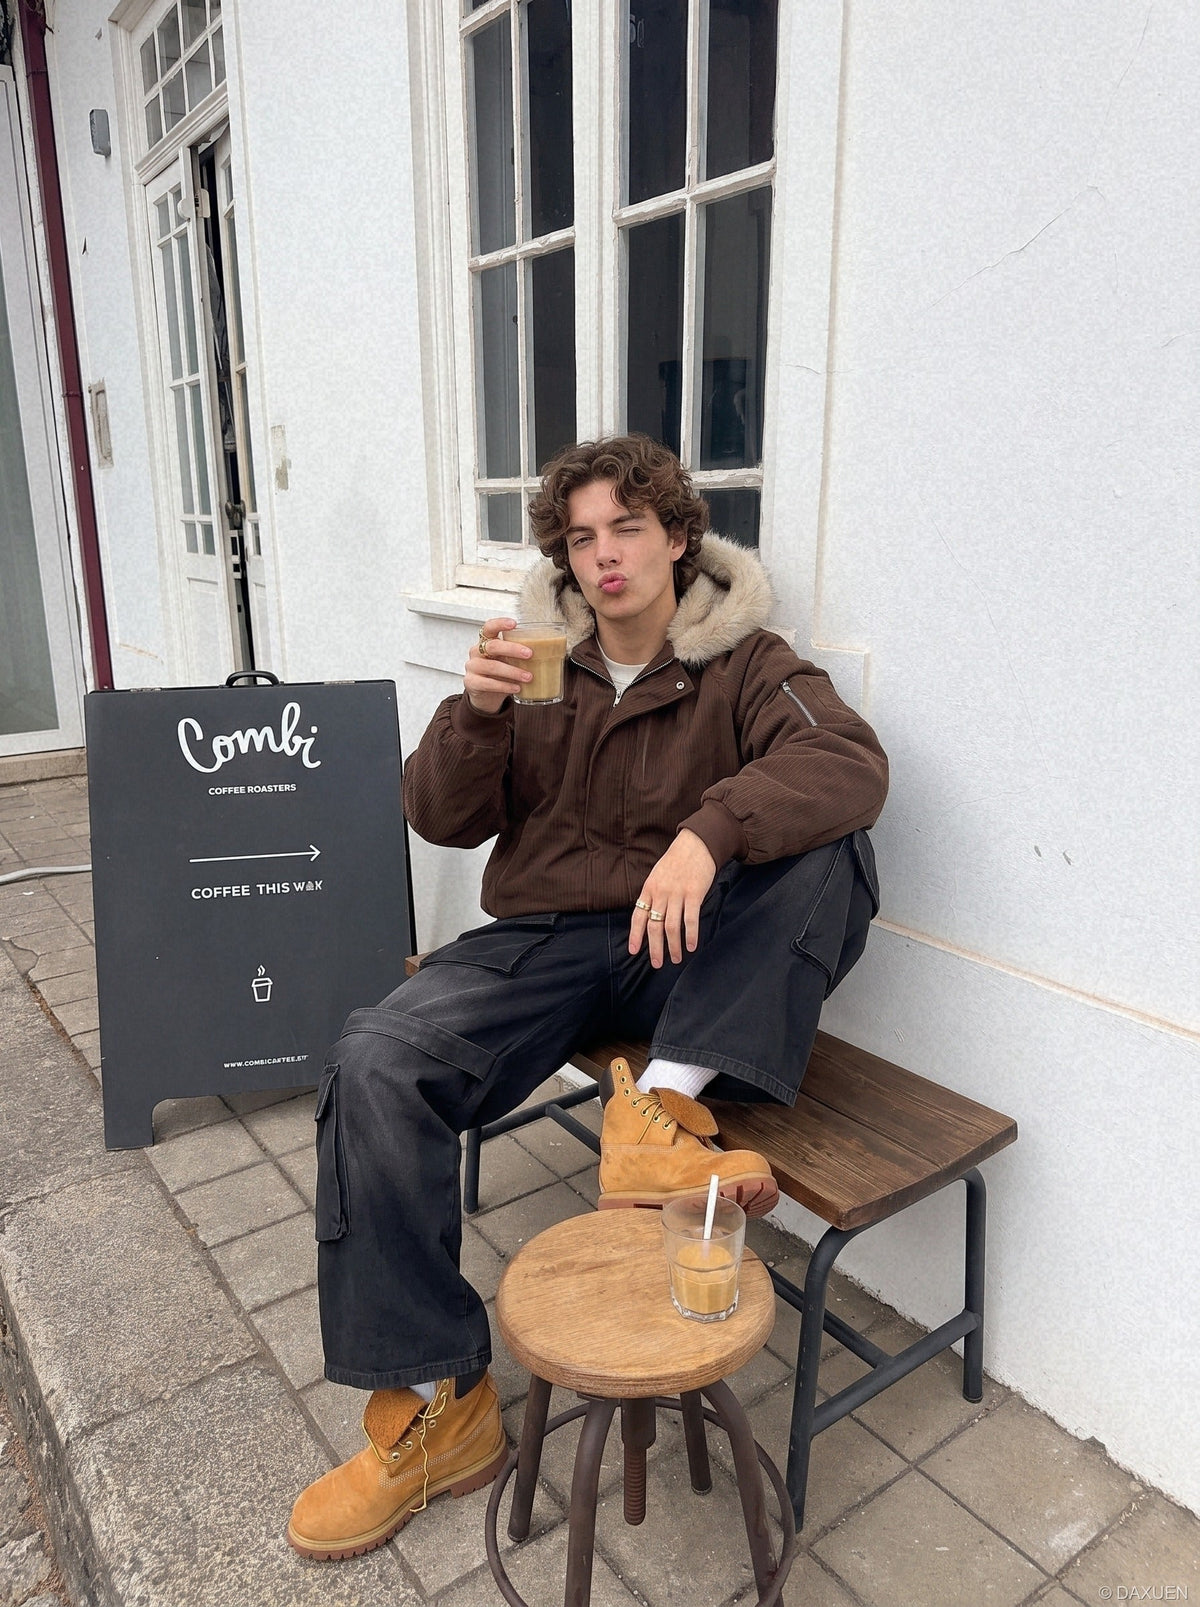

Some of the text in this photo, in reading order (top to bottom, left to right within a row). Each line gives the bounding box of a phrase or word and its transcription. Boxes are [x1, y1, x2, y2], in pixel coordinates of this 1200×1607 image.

[177, 702, 322, 773] Combi
[208, 783, 297, 796] COFFEE ROASTERS
[191, 885, 251, 900] COFFEE
[256, 882, 291, 895] THIS
